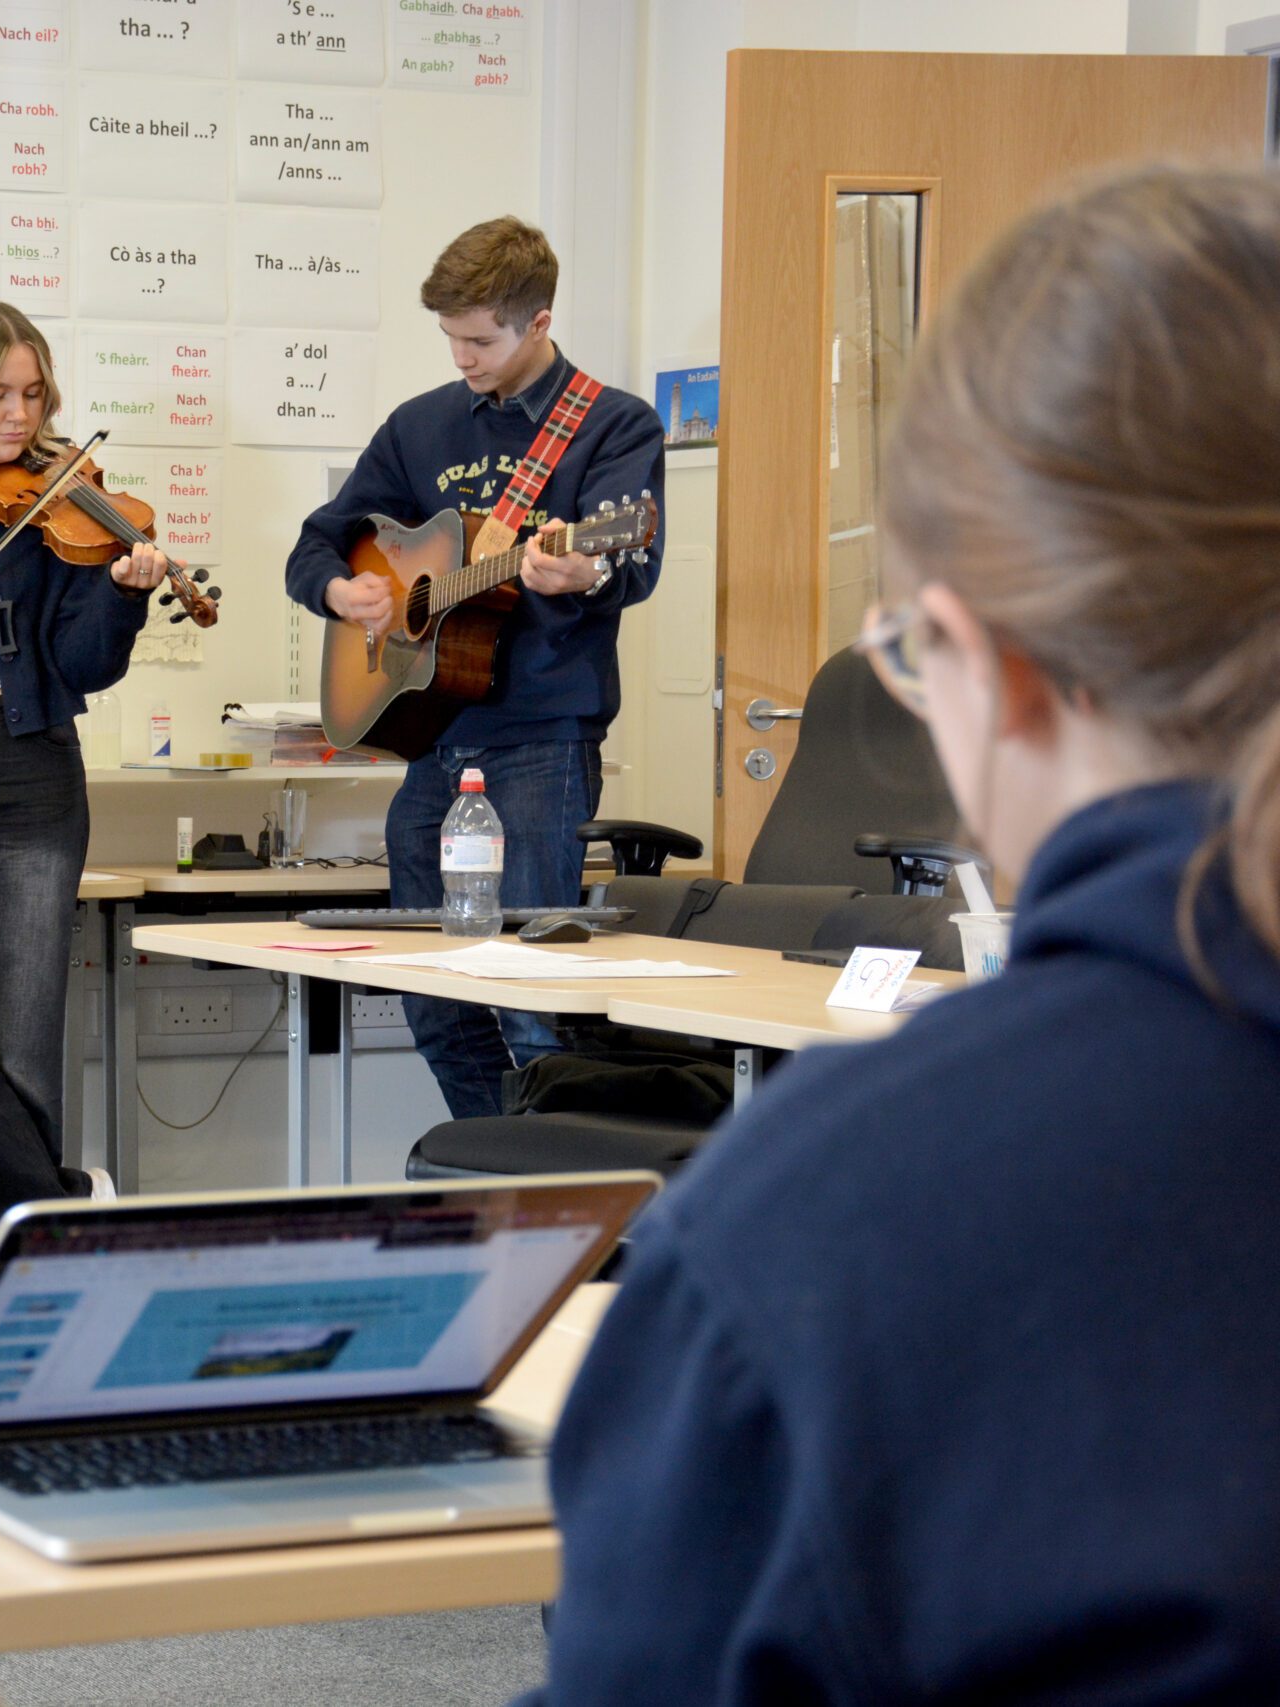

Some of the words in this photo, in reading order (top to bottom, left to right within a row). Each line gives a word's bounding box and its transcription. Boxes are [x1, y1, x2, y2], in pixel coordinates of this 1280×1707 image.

[306, 5, 315, 16] e
[462, 3, 483, 15] Cha
[486, 5, 524, 19] ghabh.
[120, 17, 151, 37] tha
[35, 28, 59, 42] eil?
[276, 33, 285, 44] a
[290, 30, 312, 46] th'
[316, 35, 346, 52] ann
[434, 30, 481, 46] ghabhas
[402, 58, 417, 70] An
[420, 61, 454, 73] gabh?
[478, 54, 506, 66] Nach
[474, 73, 509, 86] gabh?
[0, 102, 22, 114] Cha
[26, 104, 59, 117] robh.
[285, 103, 314, 121] Tha
[89, 115, 131, 136] Càite
[135, 122, 145, 136] a
[149, 118, 190, 138] bheil
[14, 142, 45, 156] Nach
[249, 134, 279, 148] ann
[284, 133, 341, 153] an/ann
[346, 138, 370, 153] am
[12, 162, 48, 176] robh?
[278, 162, 323, 181] /anns
[10, 216, 33, 229] Cha
[36, 216, 59, 231] bhi.
[6, 243, 40, 259] bhios
[110, 246, 131, 264] Cò
[135, 246, 153, 265] às
[157, 253, 167, 265] a
[170, 248, 197, 266] tha
[255, 254, 284, 271] Tha
[308, 255, 342, 275] à/às
[10, 274, 40, 288] Nach
[42, 276, 60, 290] bi?
[176, 346, 207, 358] Chan
[284, 343, 299, 358] a'
[303, 344, 328, 360] dol
[109, 354, 150, 367] fheàrr.
[171, 365, 212, 378] fheàrr.
[286, 375, 295, 388] a
[176, 394, 207, 406] Nach
[89, 401, 108, 414] An
[110, 402, 155, 416] fheàrr?
[276, 402, 317, 418] dhan
[170, 413, 213, 426] fheàrr?
[170, 464, 193, 477] Cha
[196, 464, 207, 477] b'
[436, 455, 489, 493] SUAS
[108, 473, 148, 486] fheàrr.
[170, 484, 209, 497] fheàrr.
[167, 512, 198, 525] Nach
[200, 512, 212, 526] b'
[168, 531, 211, 545] fheàrr?
